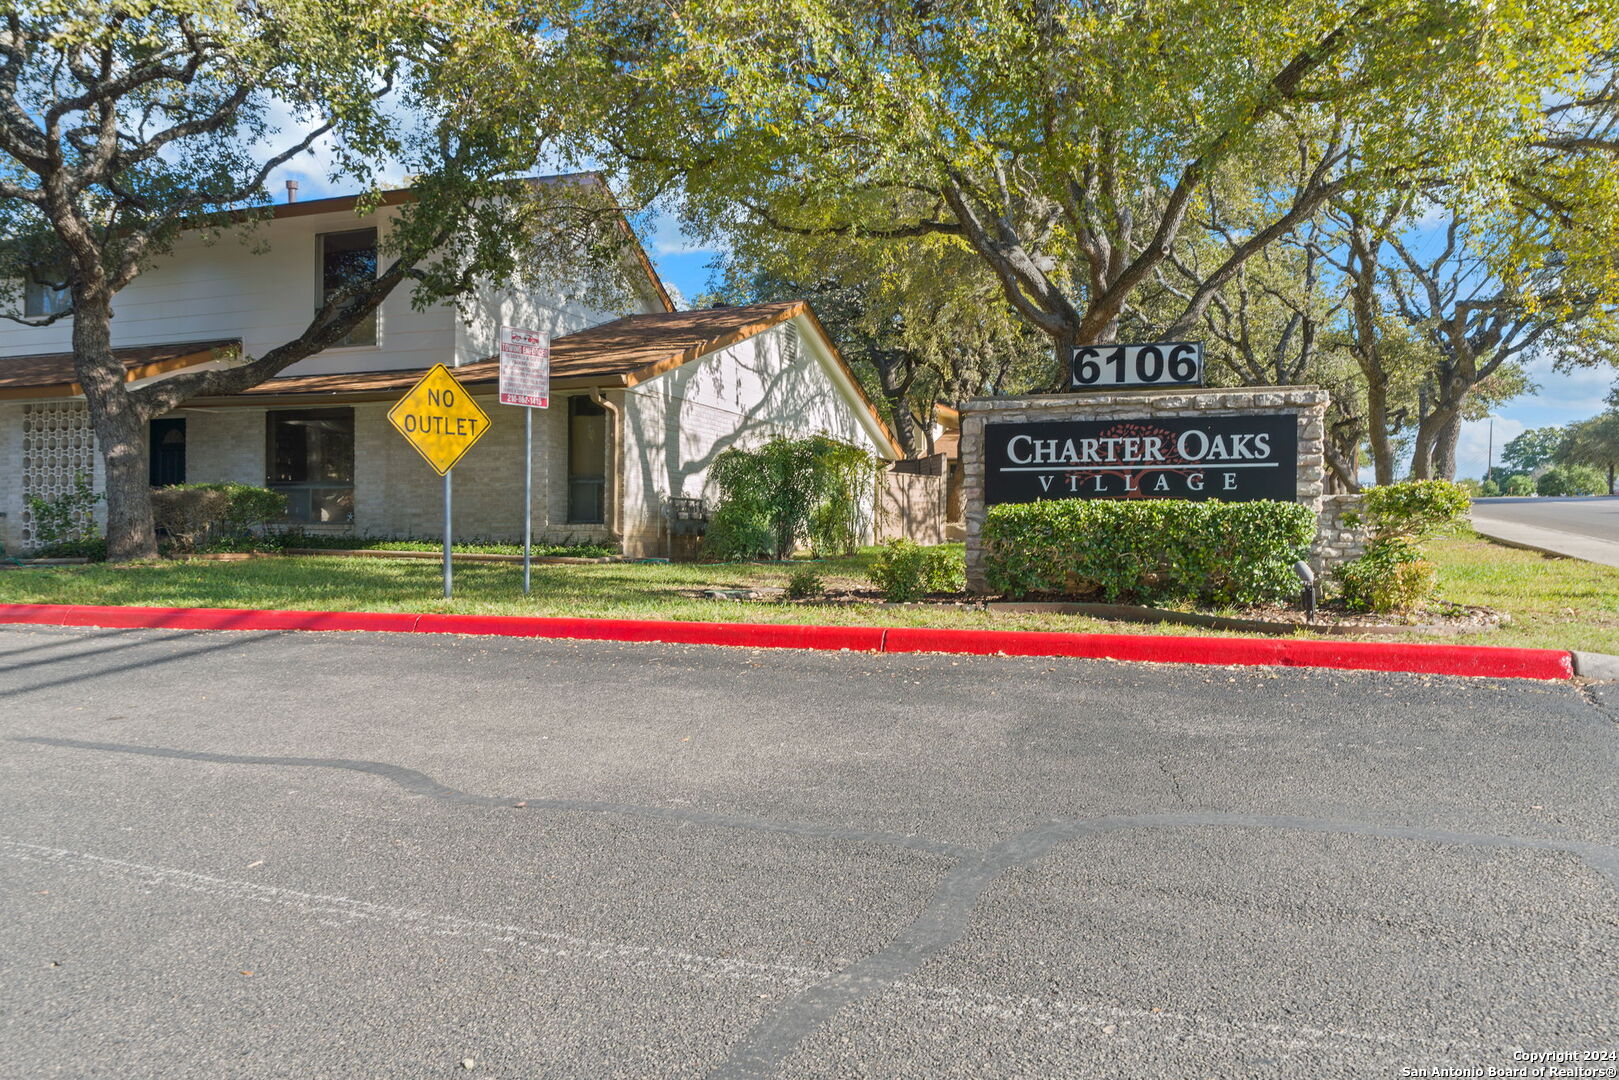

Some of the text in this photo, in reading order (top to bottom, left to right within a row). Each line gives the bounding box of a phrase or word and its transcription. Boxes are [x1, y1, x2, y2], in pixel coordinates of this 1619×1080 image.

[1073, 345, 1198, 384] 6106
[427, 388, 455, 408] NO
[404, 414, 478, 436] OUTLET
[1006, 429, 1271, 464] CHARTER OAKS
[1038, 472, 1238, 492] VILLAGE
